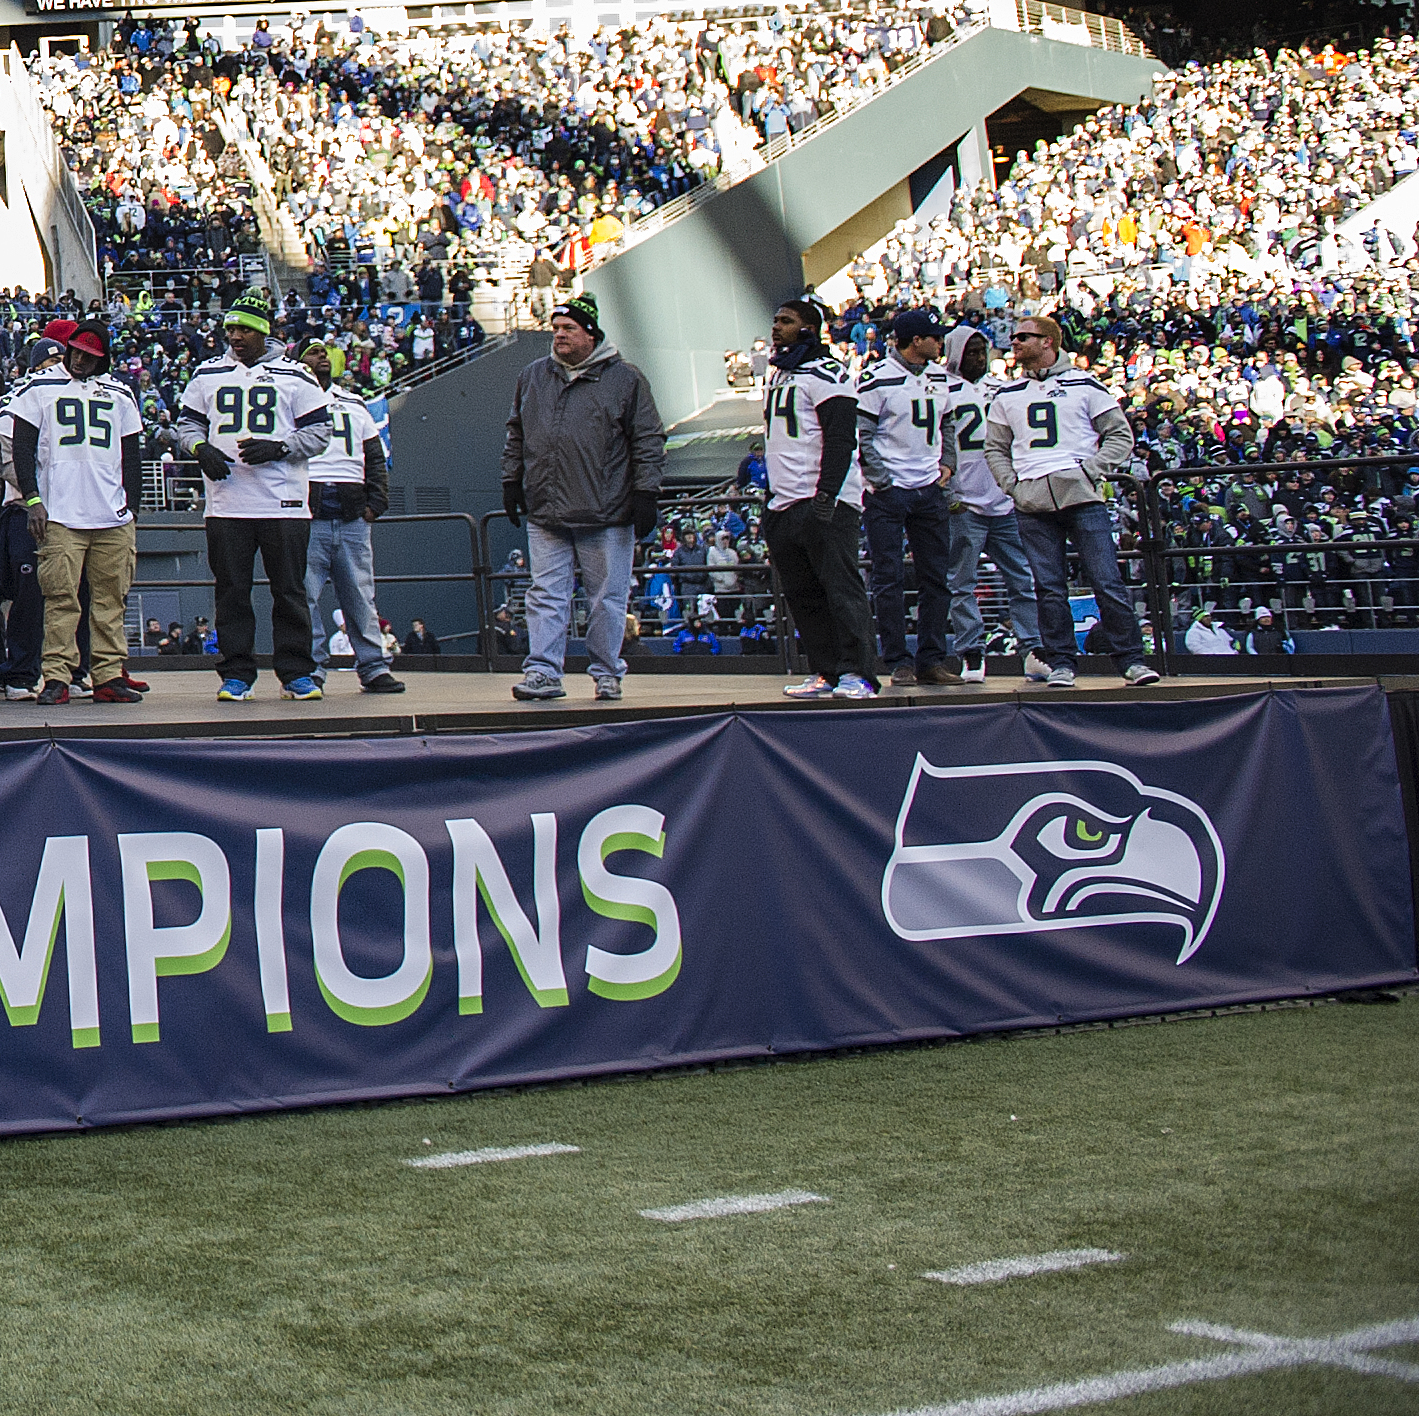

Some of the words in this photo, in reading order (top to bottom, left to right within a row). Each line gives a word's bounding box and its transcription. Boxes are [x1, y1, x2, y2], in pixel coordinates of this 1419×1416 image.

[55, 396, 115, 450] 95
[216, 384, 279, 436] 98
[911, 398, 937, 447] 4
[953, 403, 986, 452] 2
[1025, 400, 1060, 450] 9
[331, 412, 354, 458] 4
